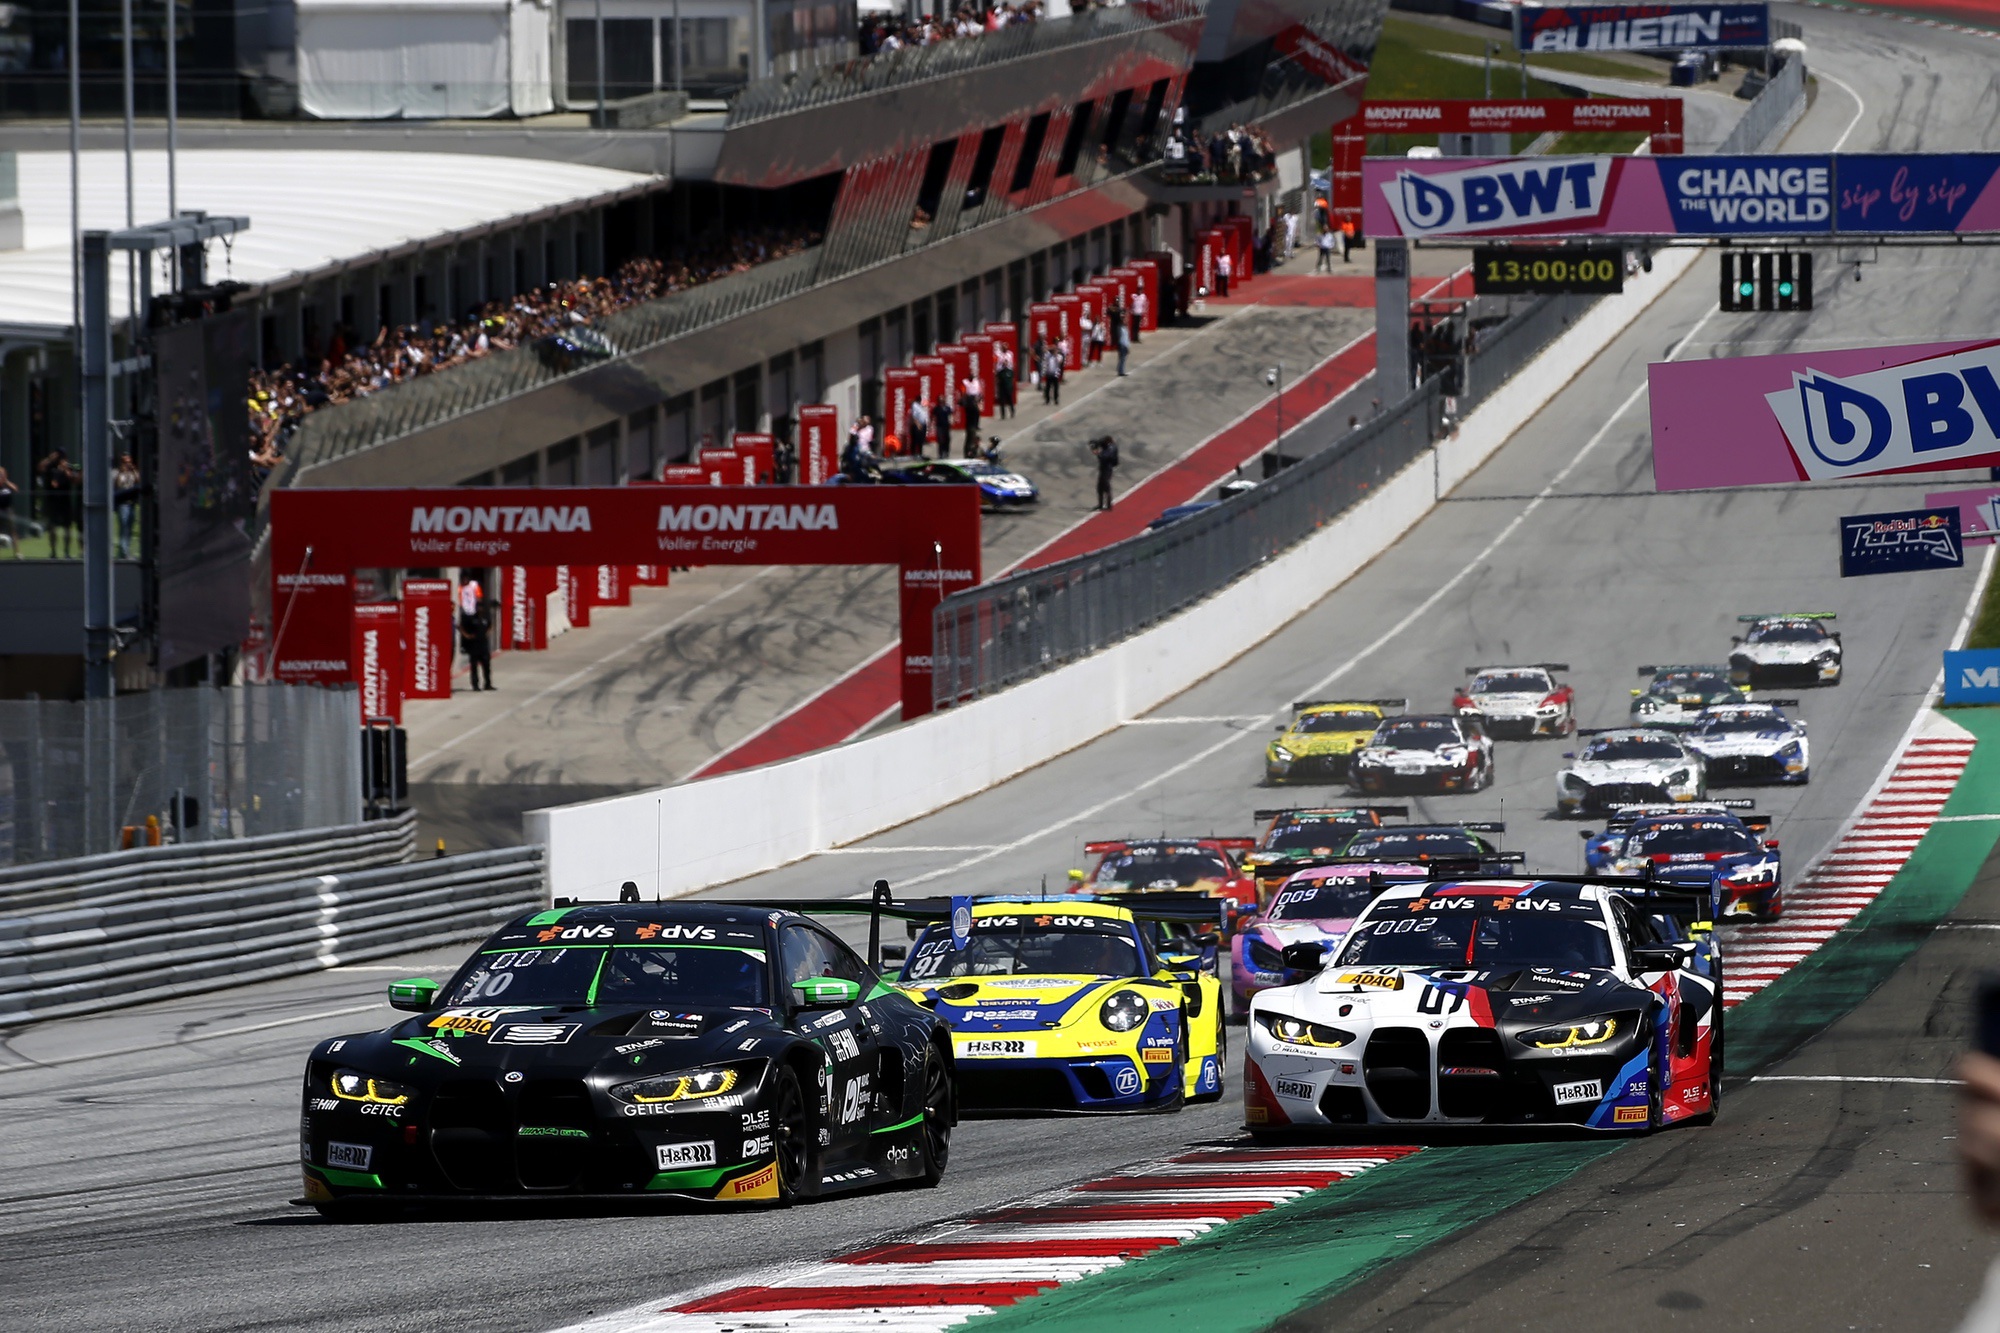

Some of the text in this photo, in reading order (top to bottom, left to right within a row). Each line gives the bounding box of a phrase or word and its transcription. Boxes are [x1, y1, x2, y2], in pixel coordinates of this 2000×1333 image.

[1532, 10, 1722, 51] BULLETIN
[1364, 106, 1442, 120] MONTANA
[1469, 106, 1546, 119] MONTANA
[1574, 104, 1650, 118] MONTANA
[1678, 167, 1829, 196] CHANGE
[1462, 162, 1596, 224] BWT
[1841, 166, 1968, 222] sip by sip
[1679, 198, 1830, 224] THE WORLD
[1486, 260, 1615, 282] 13:00:00
[409, 505, 592, 534] MONTANA
[656, 503, 839, 531] MONTANA
[410, 538, 511, 556] Voller Energie
[657, 536, 758, 553] Voller Energie
[415, 606, 429, 691] MONTANA
[364, 629, 379, 717] MONTANA
[1278, 888, 1319, 905] 009
[1373, 917, 1438, 936] 002
[909, 954, 945, 980] 91
[1351, 975, 1396, 988] ADAC
[1532, 975, 1585, 989] Motorsport
[442, 1017, 493, 1034] ADAC
[651, 1020, 698, 1029] Motorsport
[837, 1028, 860, 1060] Hill
[1145, 1050, 1170, 1061] PIRELLI
[1118, 1072, 1137, 1090] ZF
[317, 1099, 340, 1111] Hill
[718, 1094, 744, 1107] Hill
[360, 1103, 405, 1117] GETEC
[624, 1103, 675, 1116] GETEC
[741, 1109, 770, 1126] DLSE
[1617, 1108, 1648, 1120] PIRELLI
[734, 1167, 773, 1194] PIRELLI
